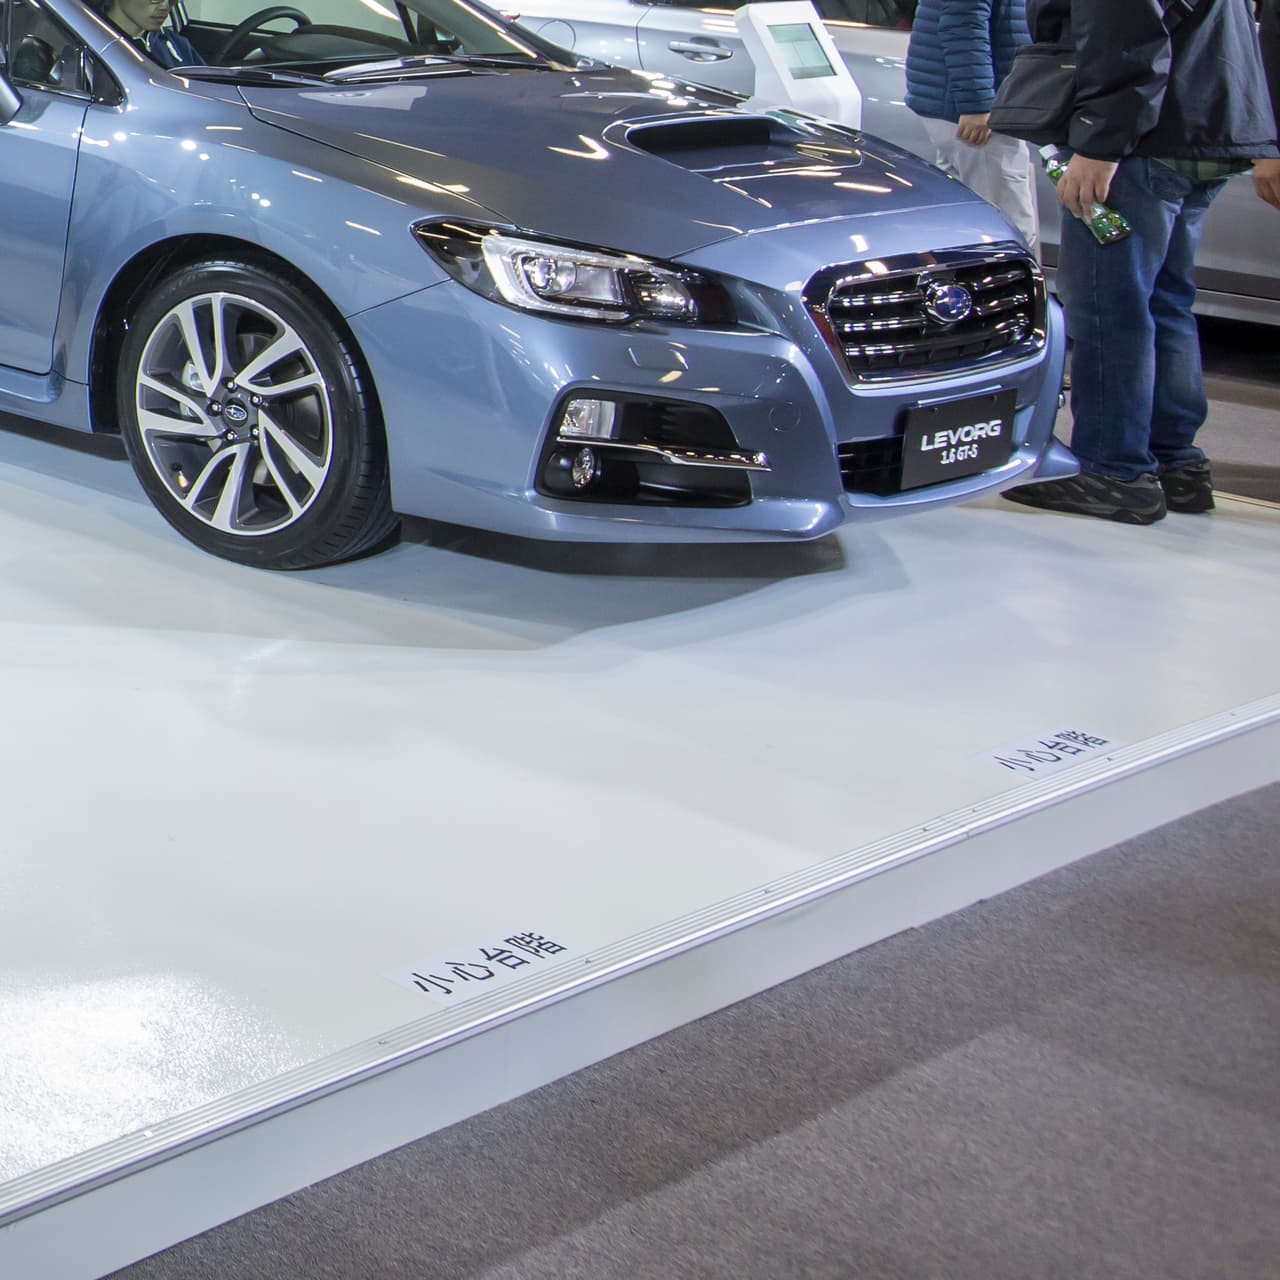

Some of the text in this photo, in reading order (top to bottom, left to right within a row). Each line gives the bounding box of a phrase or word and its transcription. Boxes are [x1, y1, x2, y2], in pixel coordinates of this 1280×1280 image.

[920, 419, 1002, 451] LEVORG
[940, 448, 956, 465] 1.6
[993, 730, 1109, 772] 小心台階
[411, 932, 568, 995] 小心台階
